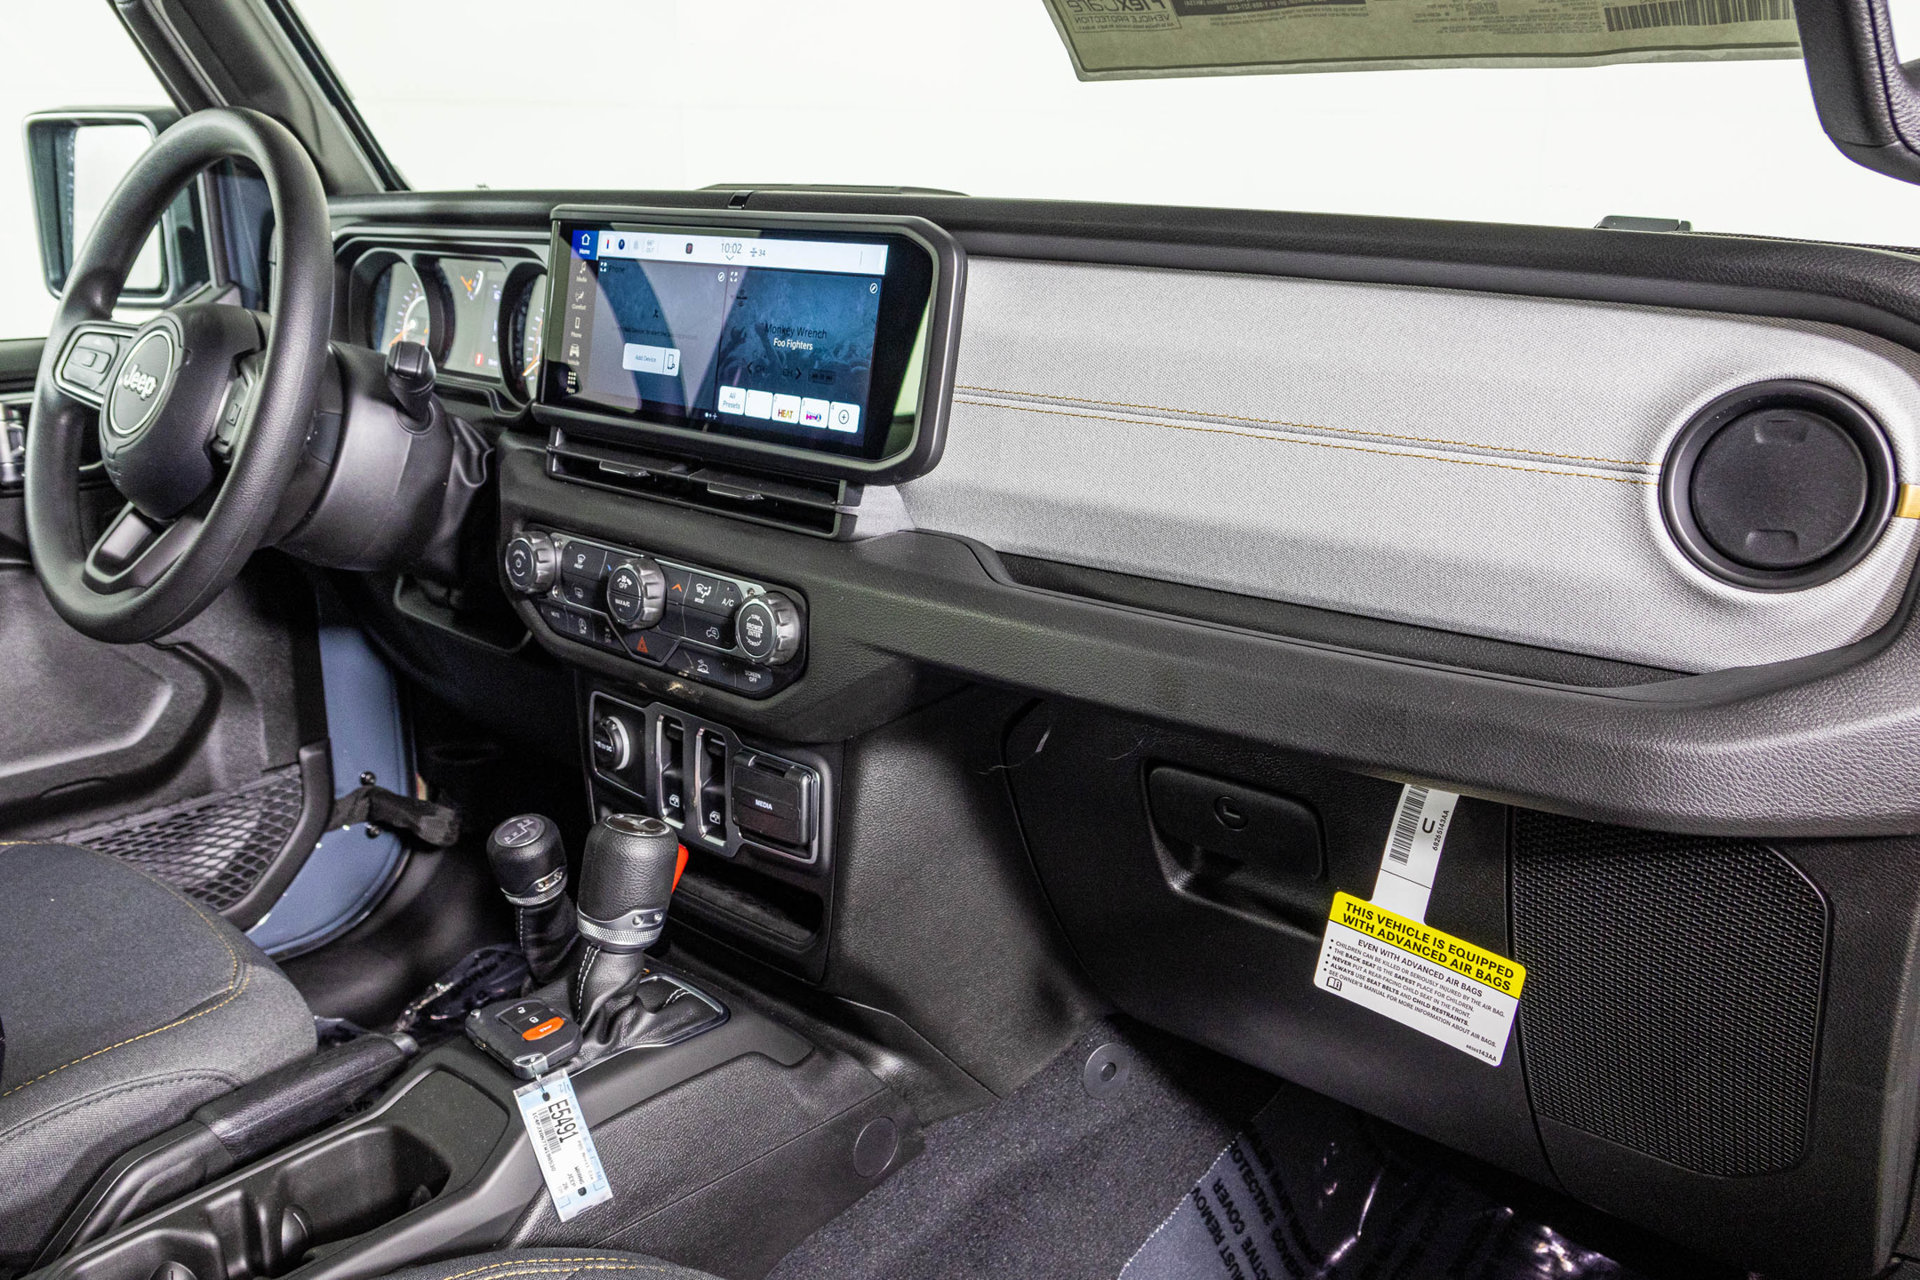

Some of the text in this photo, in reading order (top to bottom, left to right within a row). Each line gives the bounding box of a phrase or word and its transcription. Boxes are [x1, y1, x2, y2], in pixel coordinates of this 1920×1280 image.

[721, 242, 742, 255] 10:02
[765, 323, 827, 340] Monkey Wrench
[773, 338, 813, 351] Foo Fighters
[122, 364, 157, 400] Jeep
[722, 400, 741, 410] Presets
[777, 408, 793, 419] HEAT
[721, 598, 735, 607] A/C
[755, 799, 773, 811] MEDIA
[1431, 809, 1450, 852] 68265143AA
[1342, 912, 1511, 991] WITH ADVANCED AIR BAGS
[1345, 901, 1514, 978] THIS VEHICLE IS EQUIPPED
[1329, 962, 1354, 976] ALWAYS
[1354, 972, 1365, 981] USE
[1365, 977, 1381, 987] SEAT
[1381, 983, 1399, 995] BELTS
[1399, 991, 1411, 1000] AND
[1411, 996, 1431, 1008] CHILD
[1332, 955, 1351, 966] NEVER
[1351, 963, 1363, 971] PUT
[1367, 969, 1402, 988] REAR-FACING
[1401, 984, 1419, 995] CHILD
[1419, 991, 1432, 1001] SEAT
[1440, 1000, 1451, 1009] THE
[1334, 947, 1344, 956] THE
[1344, 952, 1360, 962] BACK
[1361, 959, 1376, 968] SEAT
[1382, 967, 1393, 976] THE
[1393, 972, 1416, 985] SAFEST
[1415, 981, 1433, 994] PLACE
[1433, 989, 1445, 998] FOR
[1335, 940, 1362, 955] CHILDREN
[1361, 951, 1373, 960] CAN
[1381, 959, 1401, 971] KILLED
[1400, 967, 1409, 975] OR
[1409, 971, 1438, 987] SERIOUSLY
[1438, 983, 1462, 997] INJURED
[1470, 997, 1481, 1006] THE
[1357, 938, 1482, 997] EVEN WITH ADVANCED AIR BAGS
[1328, 969, 1338, 977] SEE
[1338, 973, 1363, 987] OWNER'S
[1363, 983, 1385, 997] MANUAL
[1386, 993, 1397, 1002] FOR
[1397, 998, 1413, 1009] MORE
[1413, 1005, 1451, 1026] INFORMATION
[1450, 1022, 1470, 1034] ABOUT
[1470, 1031, 1480, 1039] AIR
[547, 1099, 579, 1144] E5491
[1212, 1176, 1246, 1235] COVER
